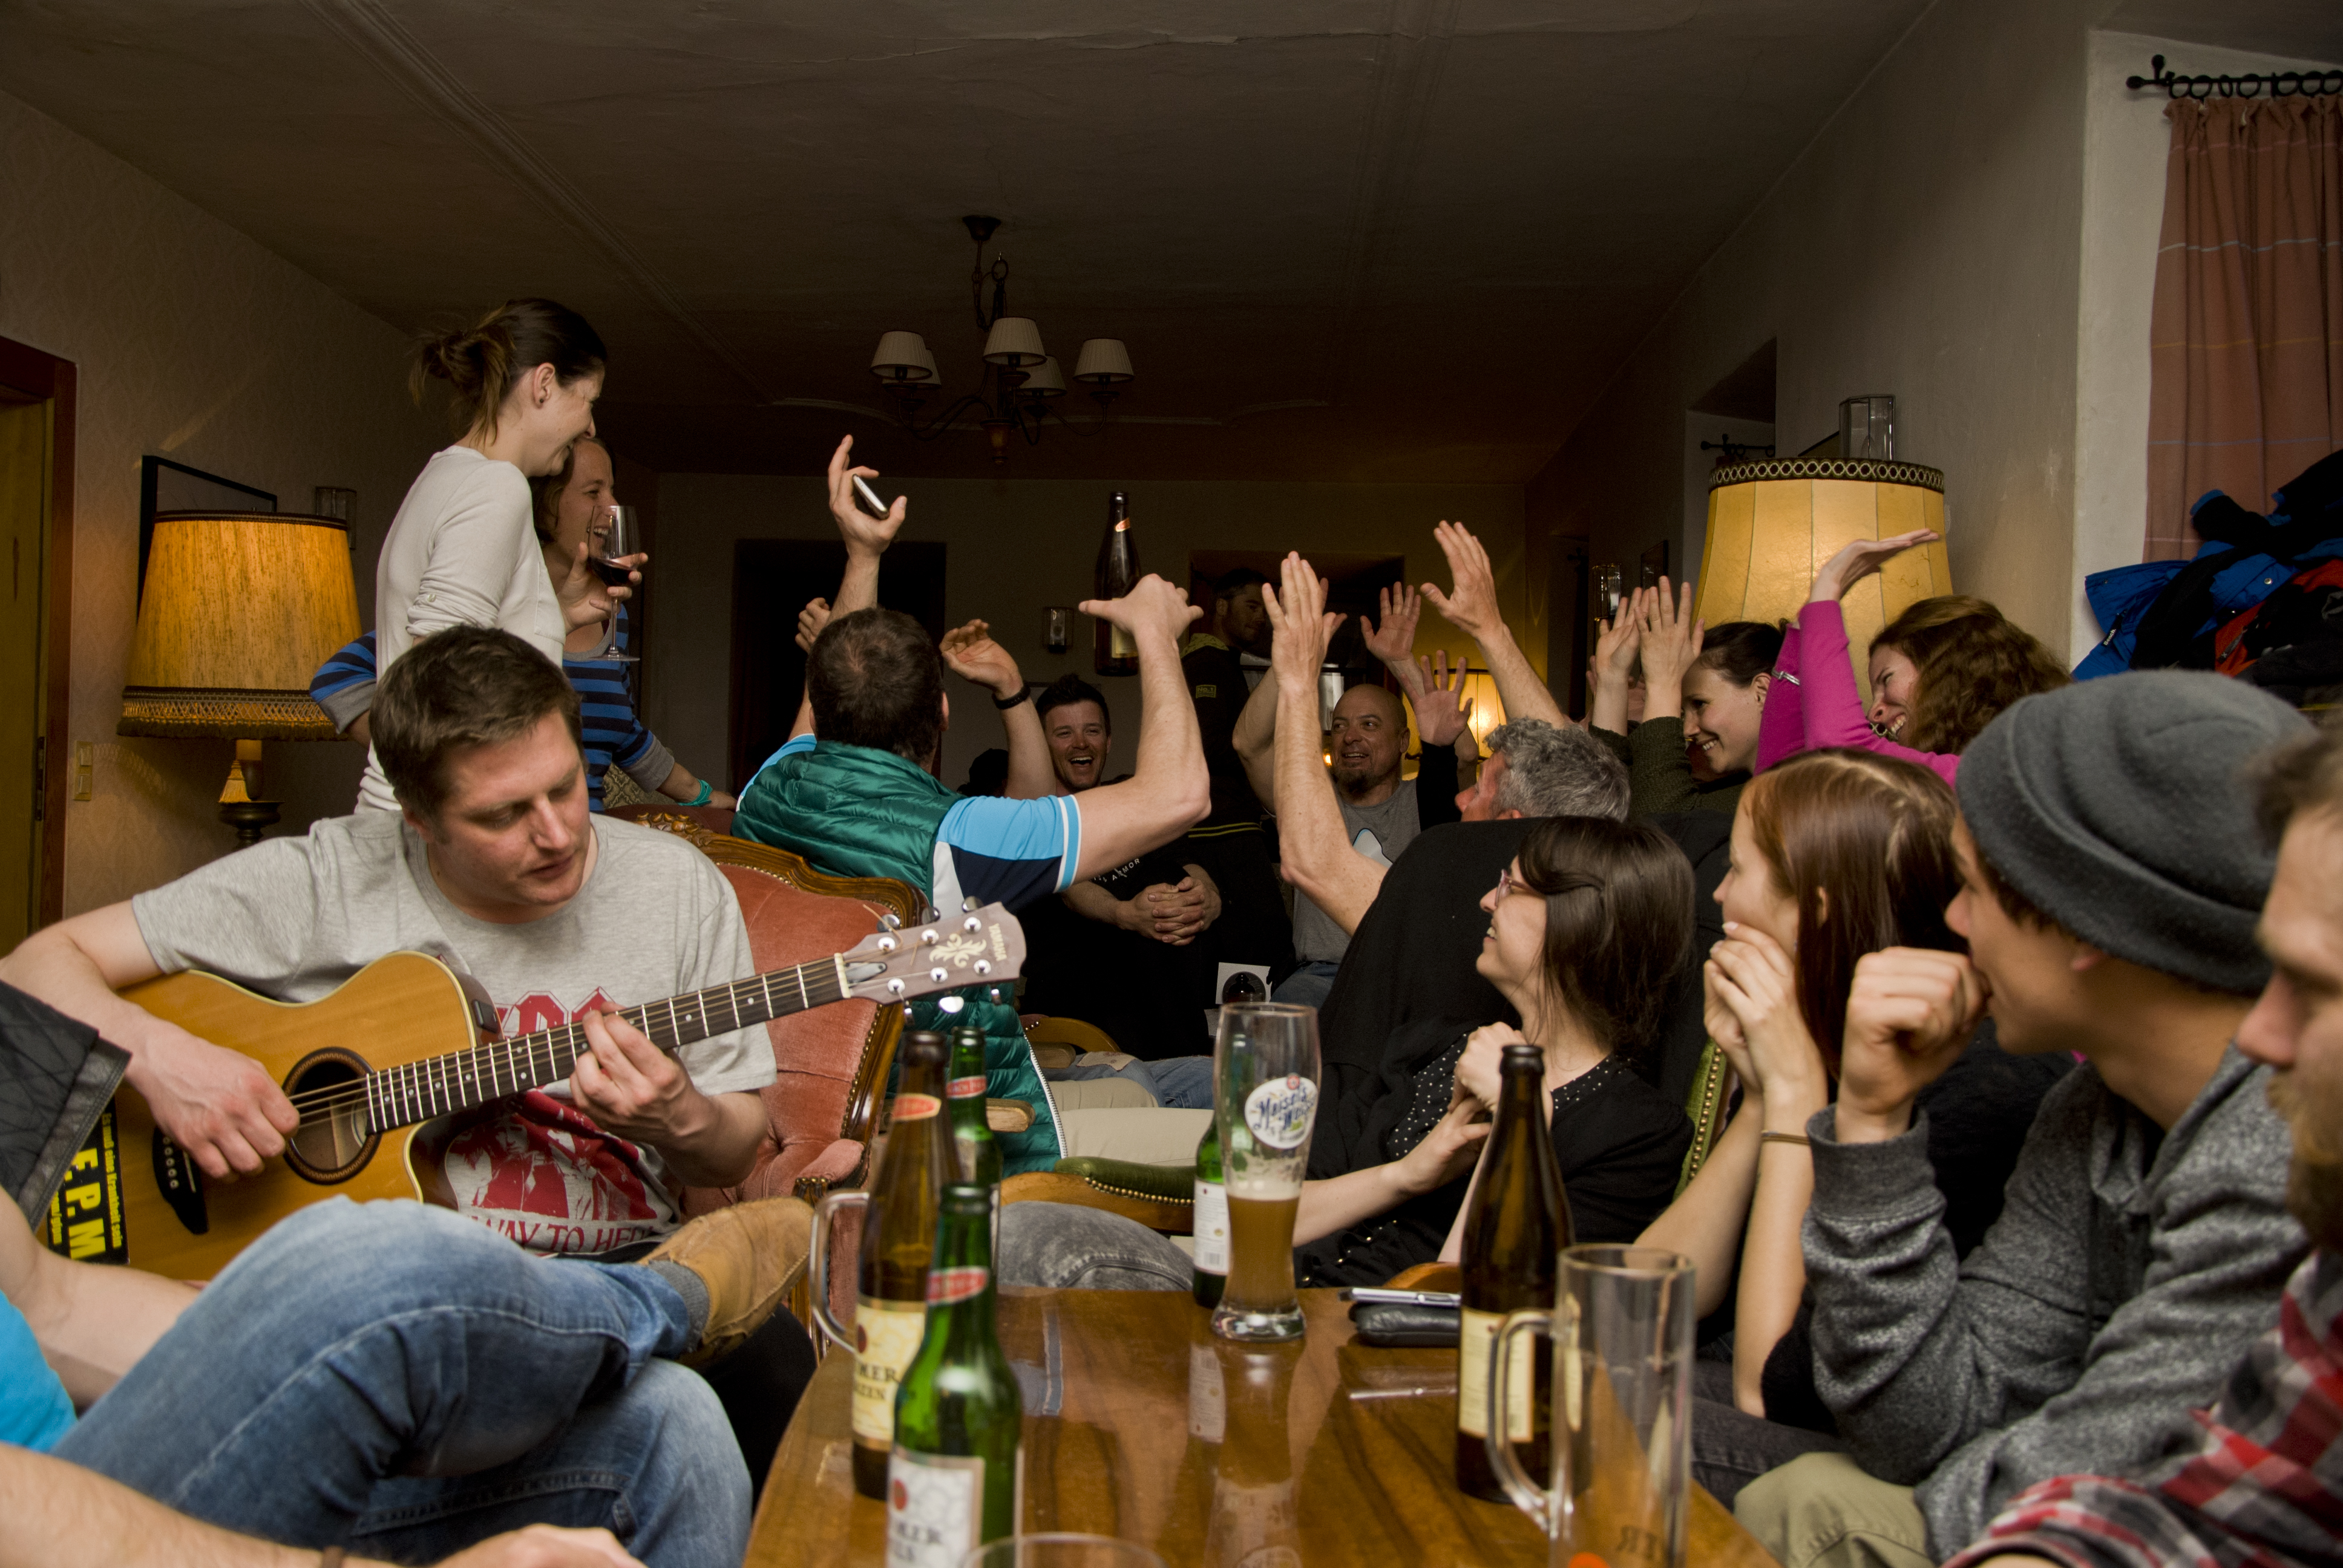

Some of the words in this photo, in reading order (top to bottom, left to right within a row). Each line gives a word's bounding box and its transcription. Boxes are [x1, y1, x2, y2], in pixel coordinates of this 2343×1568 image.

[1112, 858, 1140, 881] ARMOR
[988, 923, 1007, 962] YAMAHA
[105, 1149, 116, 1173] eine
[107, 1173, 120, 1223] Krankheit
[112, 1223, 123, 1249] sein
[548, 1223, 585, 1252] TO
